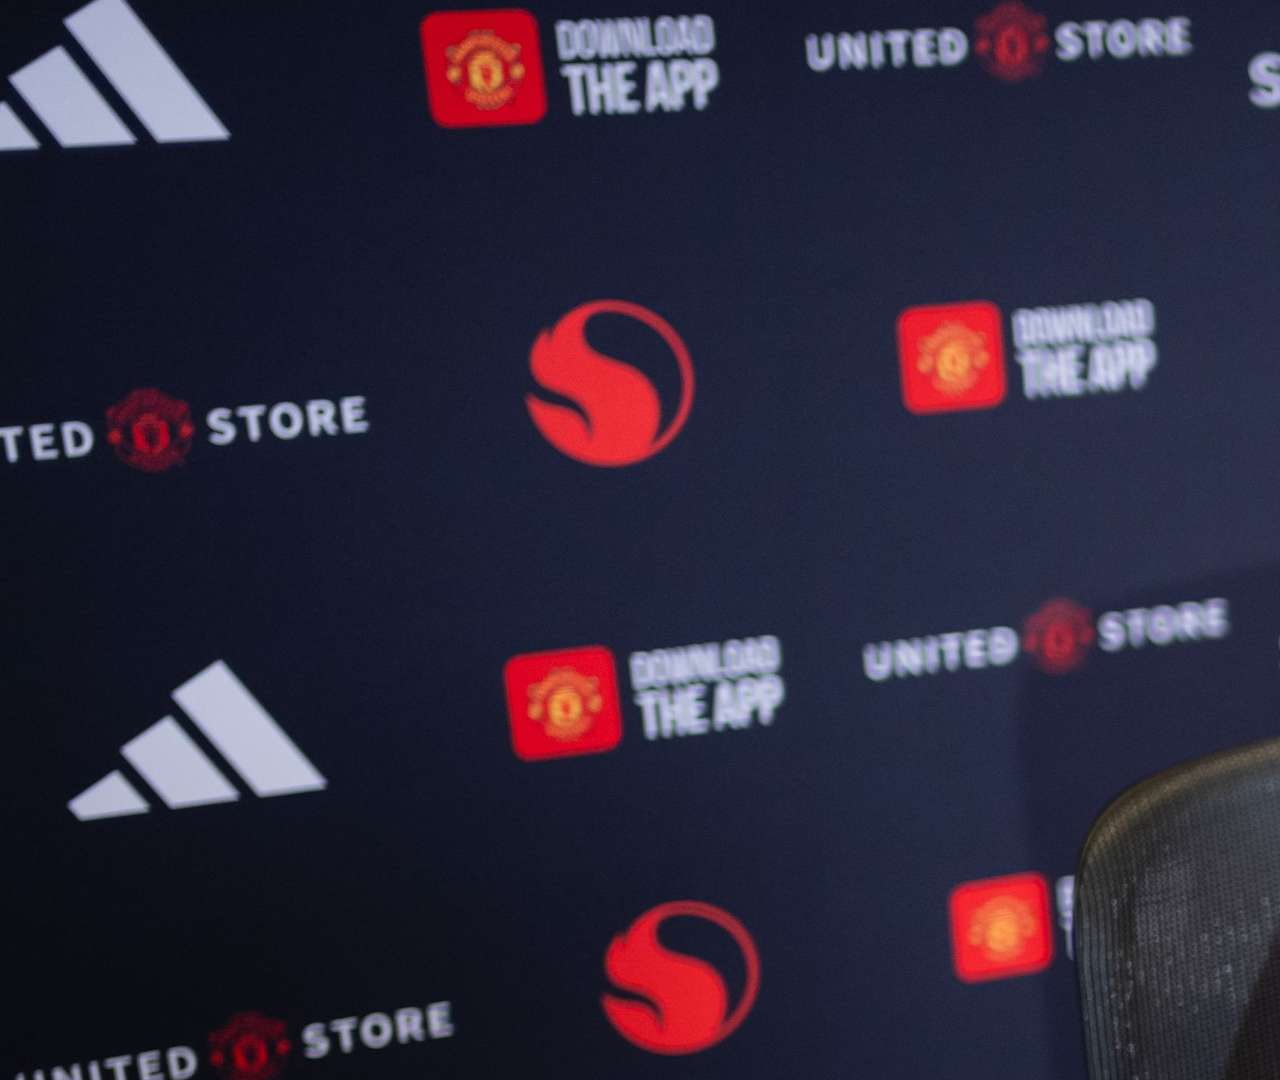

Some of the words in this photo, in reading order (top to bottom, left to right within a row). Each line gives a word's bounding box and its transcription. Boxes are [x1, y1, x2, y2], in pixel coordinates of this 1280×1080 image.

[555, 14, 716, 61] DOWNLOAD
[805, 27, 969, 72] UNITED
[1055, 16, 1193, 61] STORE
[560, 61, 641, 116] THE
[645, 57, 719, 113] APP
[206, 396, 369, 445] STORE
[629, 634, 781, 690] DOWNLOAD
[863, 626, 1020, 682] UNITED
[1098, 597, 1228, 652] STORE
[633, 682, 709, 740] THE
[712, 673, 785, 732] APP
[302, 1001, 454, 1059] STORE
